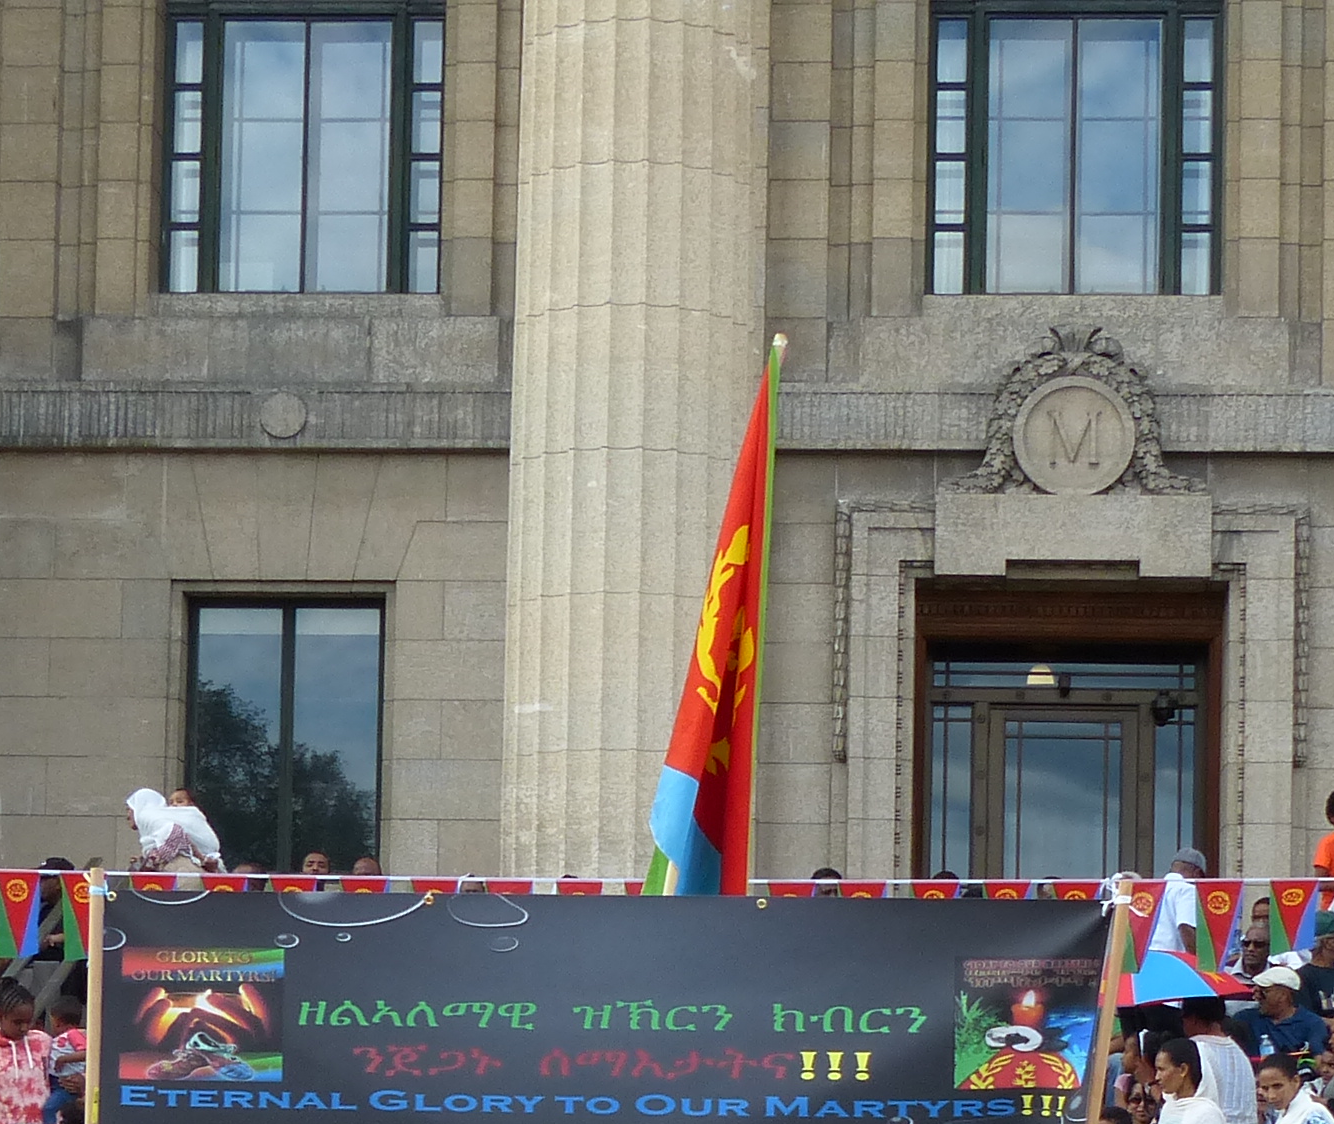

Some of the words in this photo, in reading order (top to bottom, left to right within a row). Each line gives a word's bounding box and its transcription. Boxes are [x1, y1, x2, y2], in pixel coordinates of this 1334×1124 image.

[1047, 409, 1103, 467] M
[156, 950, 219, 964] GLORY
[131, 969, 173, 982] OUR
